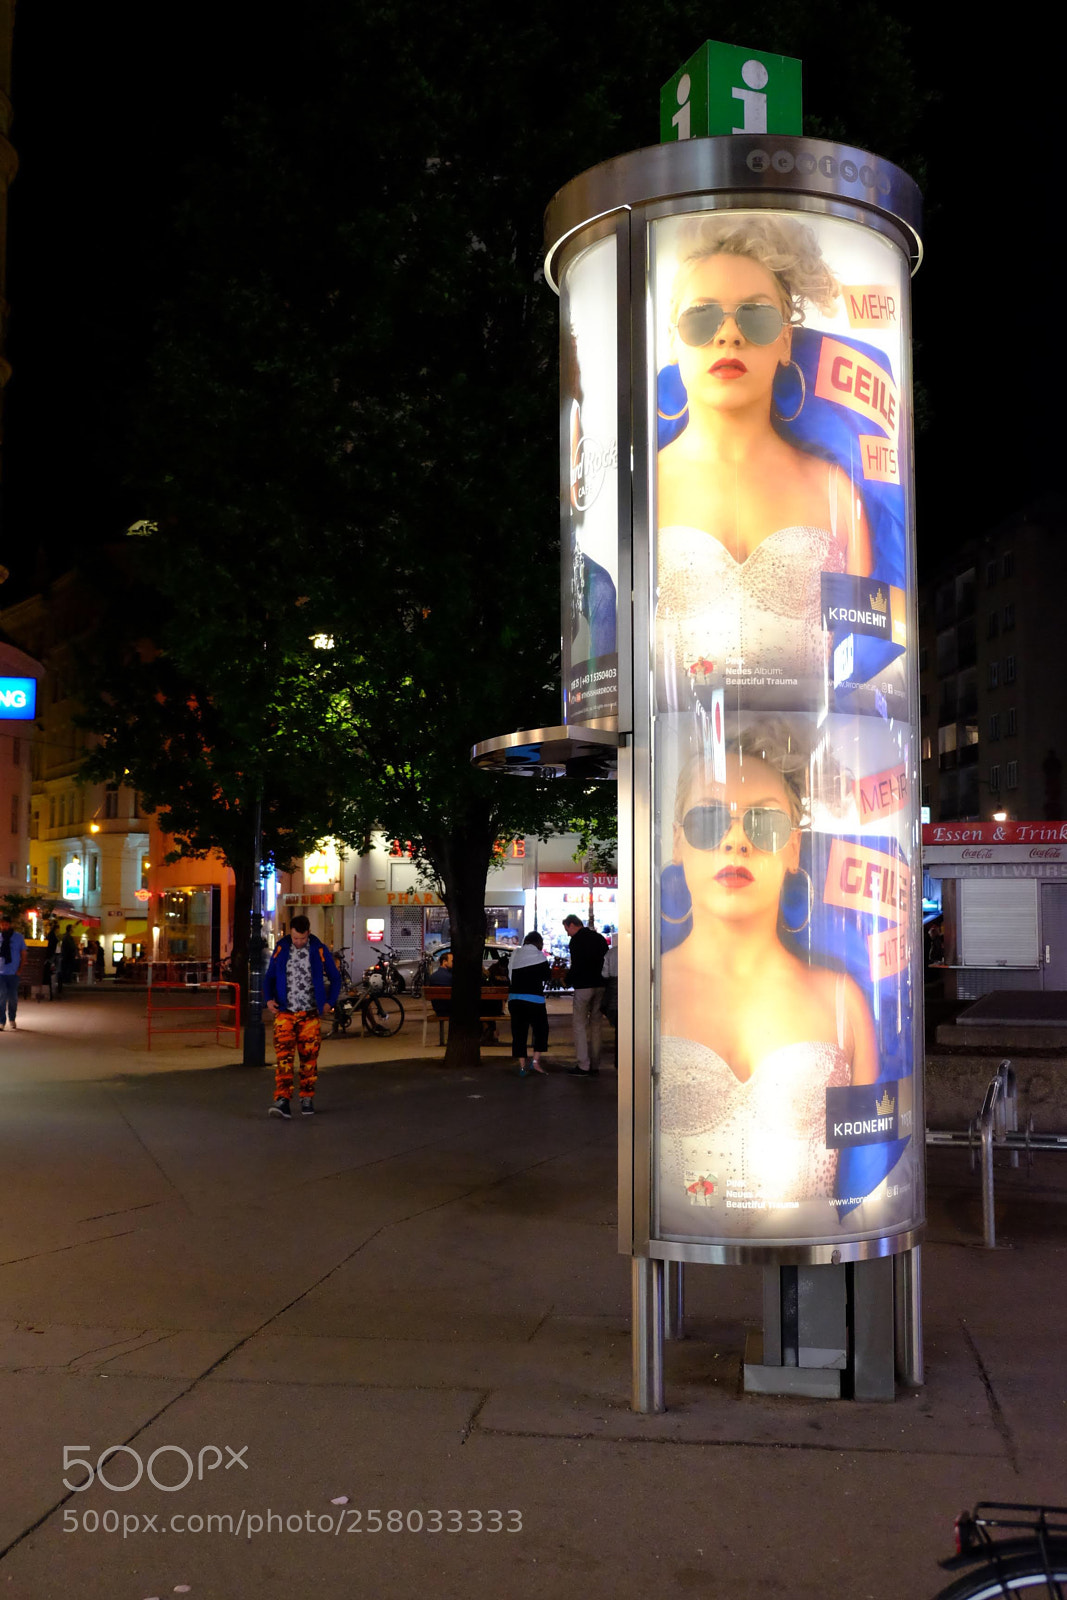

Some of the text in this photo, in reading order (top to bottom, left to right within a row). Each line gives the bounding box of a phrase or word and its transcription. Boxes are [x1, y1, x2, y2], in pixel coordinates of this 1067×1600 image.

[850, 294, 896, 321] MEHR
[831, 355, 896, 430] GEILE
[866, 444, 897, 474] HITS
[829, 607, 887, 629] KRONEHIT
[725, 676, 798, 685] Beautiful Trauma
[860, 773, 907, 814] MEHR
[933, 827, 983, 841] Essen
[992, 826, 1006, 841] &
[840, 857, 907, 913] GEILE
[834, 1116, 894, 1137] KRONEHIT
